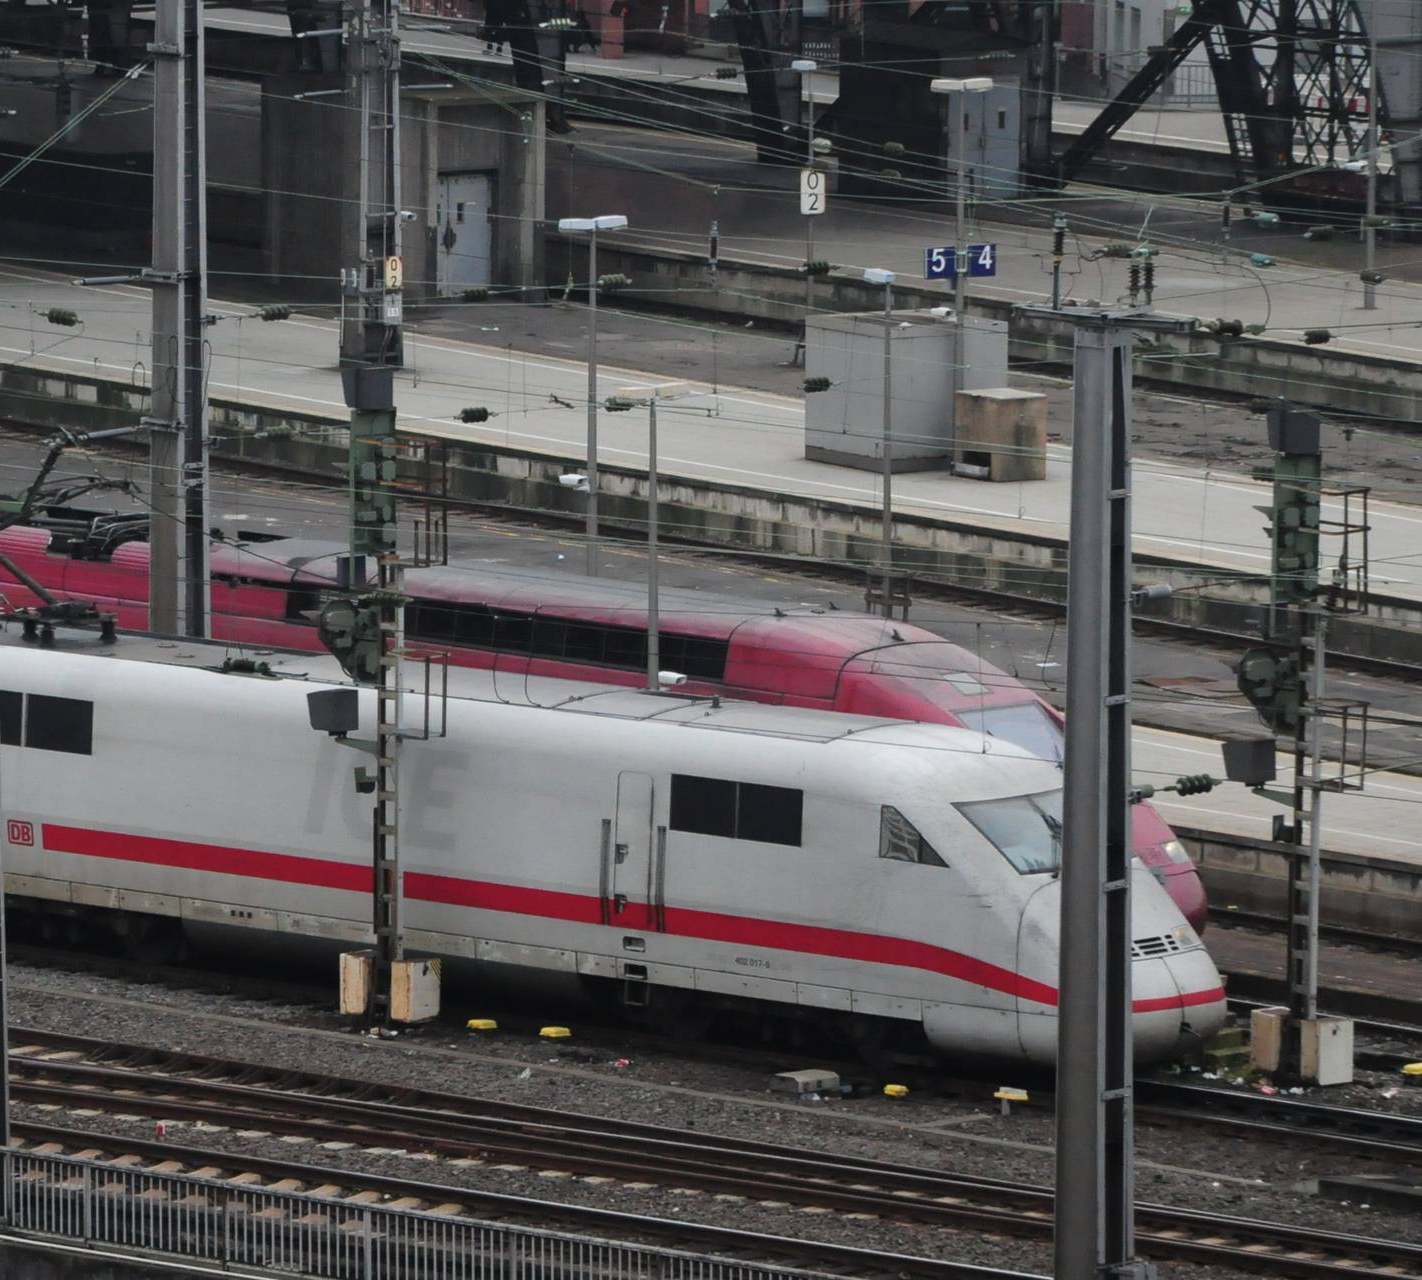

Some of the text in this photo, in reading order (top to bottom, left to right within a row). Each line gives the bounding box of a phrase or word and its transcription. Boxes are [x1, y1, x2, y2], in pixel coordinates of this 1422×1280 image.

[807, 171, 819, 190] 0
[808, 193, 818, 211] 2
[390, 258, 398, 272] 0
[931, 248, 946, 272] 5
[978, 245, 992, 270] 4
[390, 275, 398, 288] 2
[10, 823, 31, 842] DB
